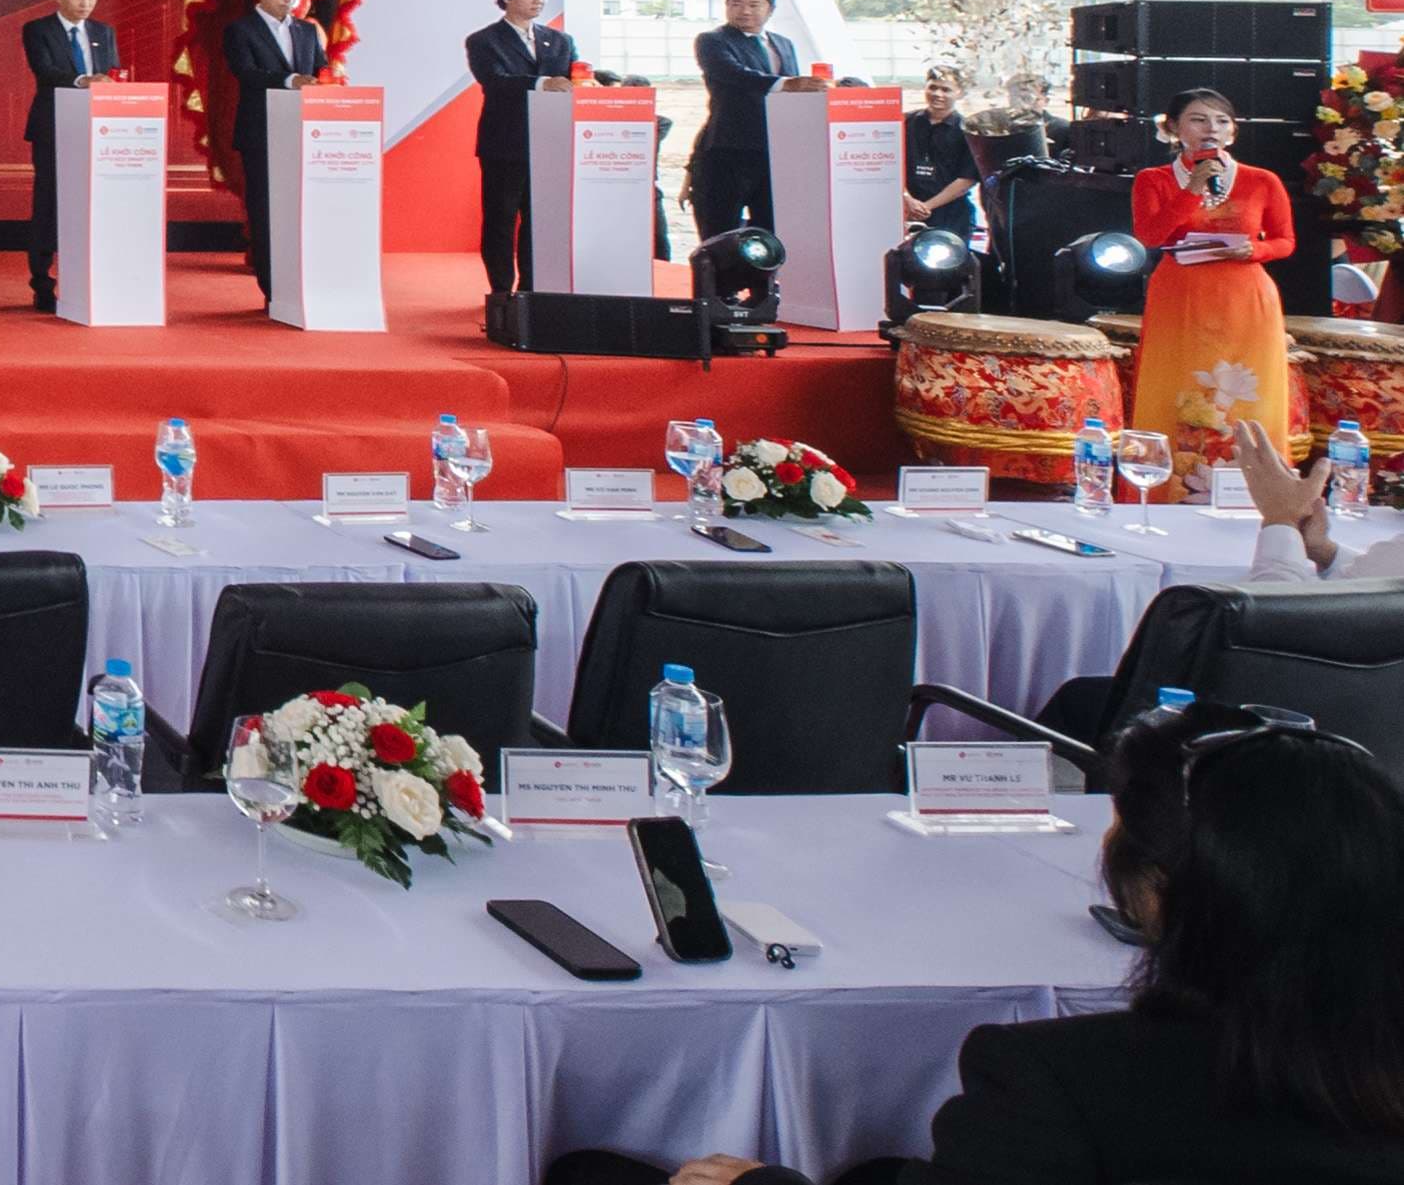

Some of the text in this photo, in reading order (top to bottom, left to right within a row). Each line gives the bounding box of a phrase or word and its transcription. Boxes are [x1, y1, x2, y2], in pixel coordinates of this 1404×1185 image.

[18, 780, 35, 789] THI
[37, 781, 59, 789] ANH
[61, 781, 81, 790] THU
[533, 783, 572, 791] NGUYEN
